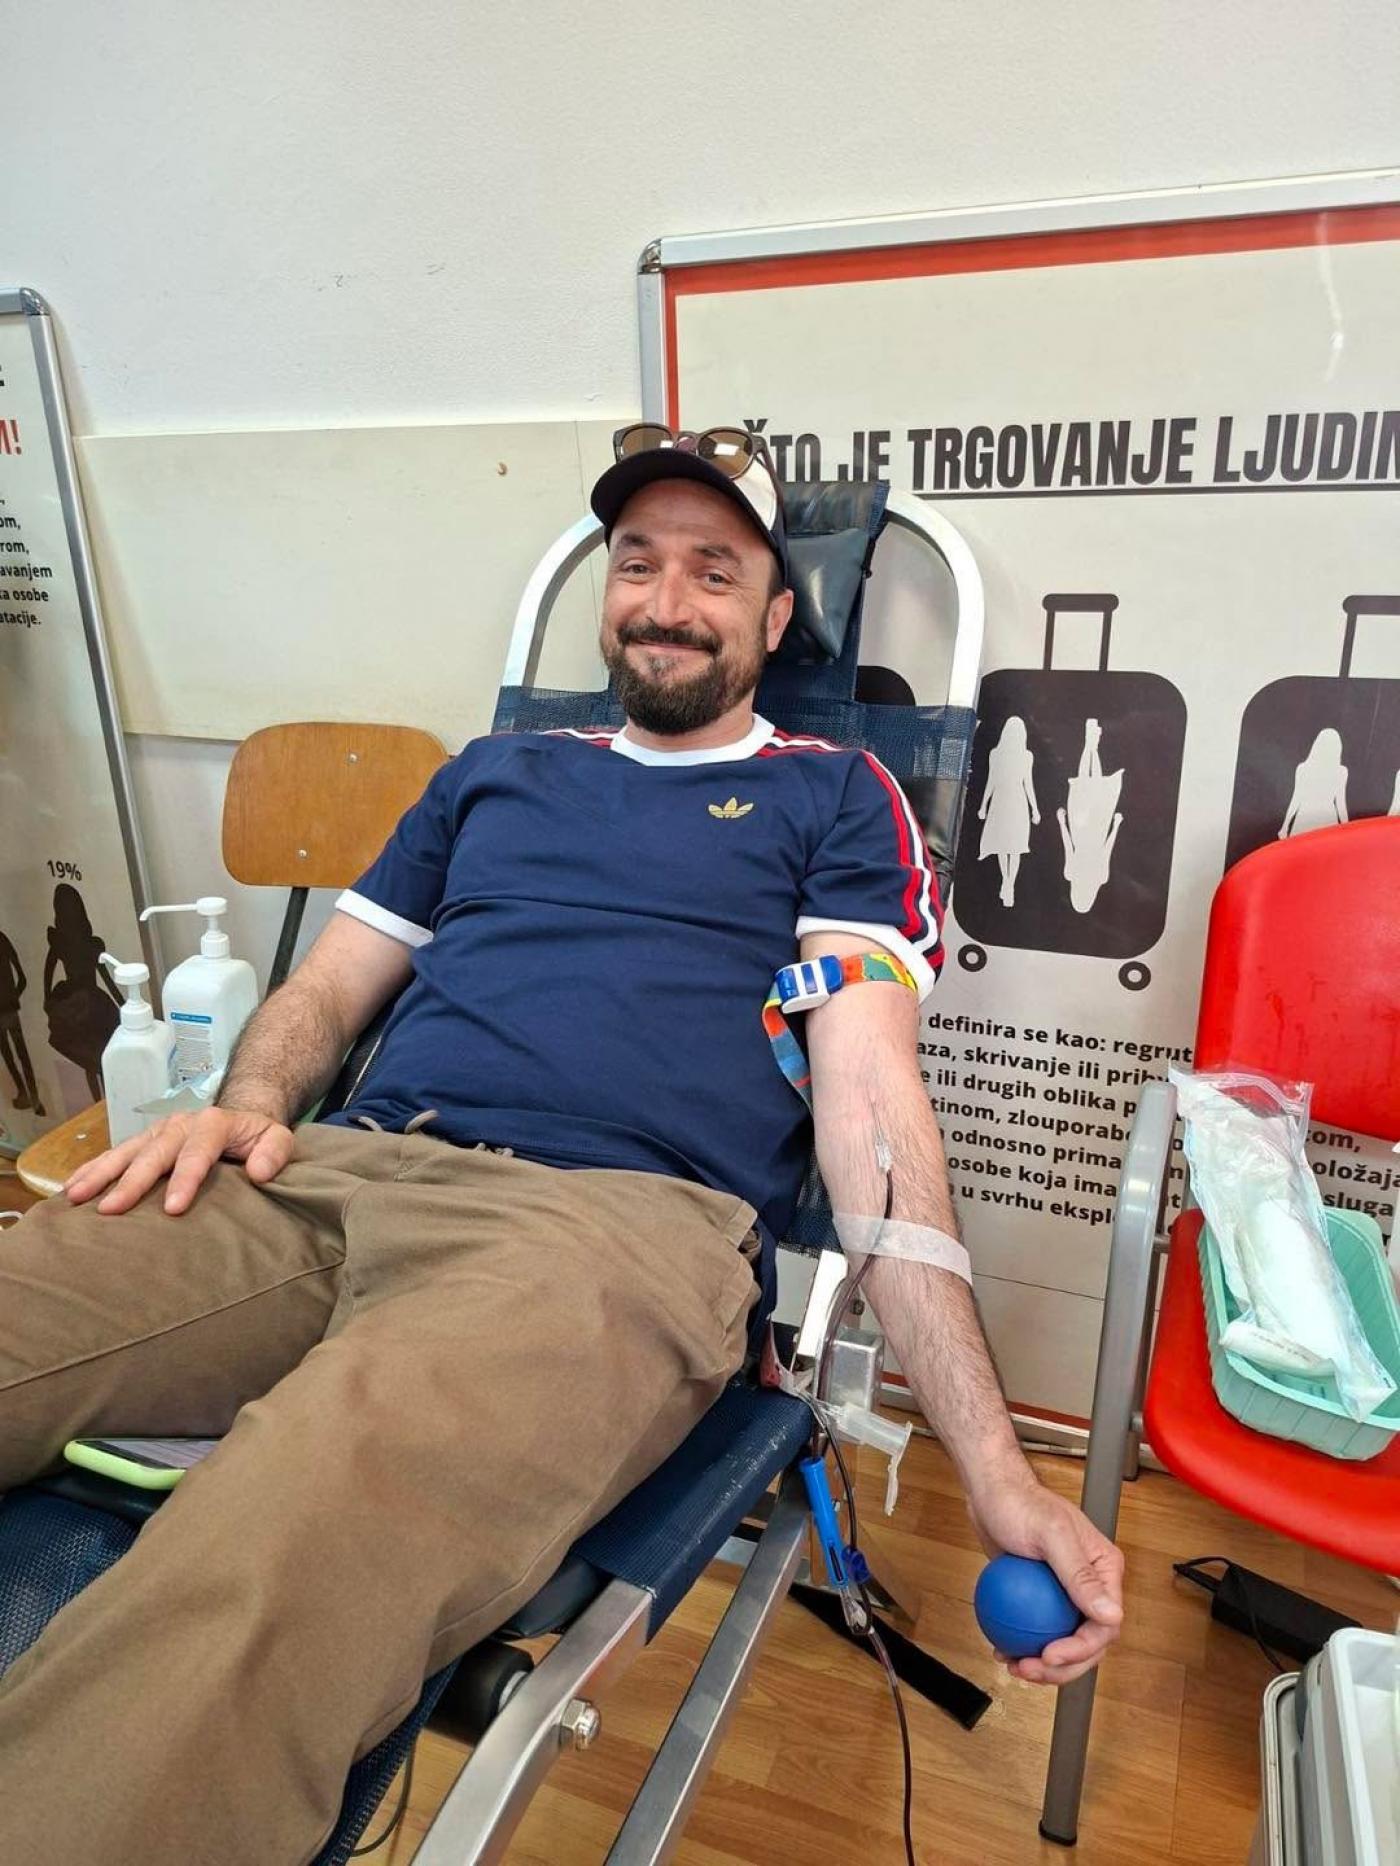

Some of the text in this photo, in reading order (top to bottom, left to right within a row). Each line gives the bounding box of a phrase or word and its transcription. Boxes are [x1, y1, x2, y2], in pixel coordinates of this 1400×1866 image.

[838, 430, 891, 483] JE
[907, 417, 1197, 490] TRGOVANJE
[13, 588, 49, 602] osobe
[47, 859, 82, 881] 19%
[928, 1012, 1016, 1039] definira
[1023, 1028, 1049, 1043] se
[1055, 1029, 1106, 1051] kao:
[1113, 1040, 1193, 1062] regrut
[963, 1047, 1071, 1078] skrivanje
[1078, 1061, 1100, 1080] ili
[937, 1069, 956, 1086] ili
[963, 1074, 1037, 1100] drugih
[1043, 1086, 1116, 1111] oblika
[930, 1097, 1001, 1124] tinom,
[951, 1129, 1047, 1157] odnosno
[1053, 1146, 1122, 1170] prima
[948, 1157, 1117, 1197] osobe koja ima
[961, 1185, 974, 1199] u
[981, 1189, 1043, 1212] svrhu
[1050, 1200, 1115, 1226] ekspl
